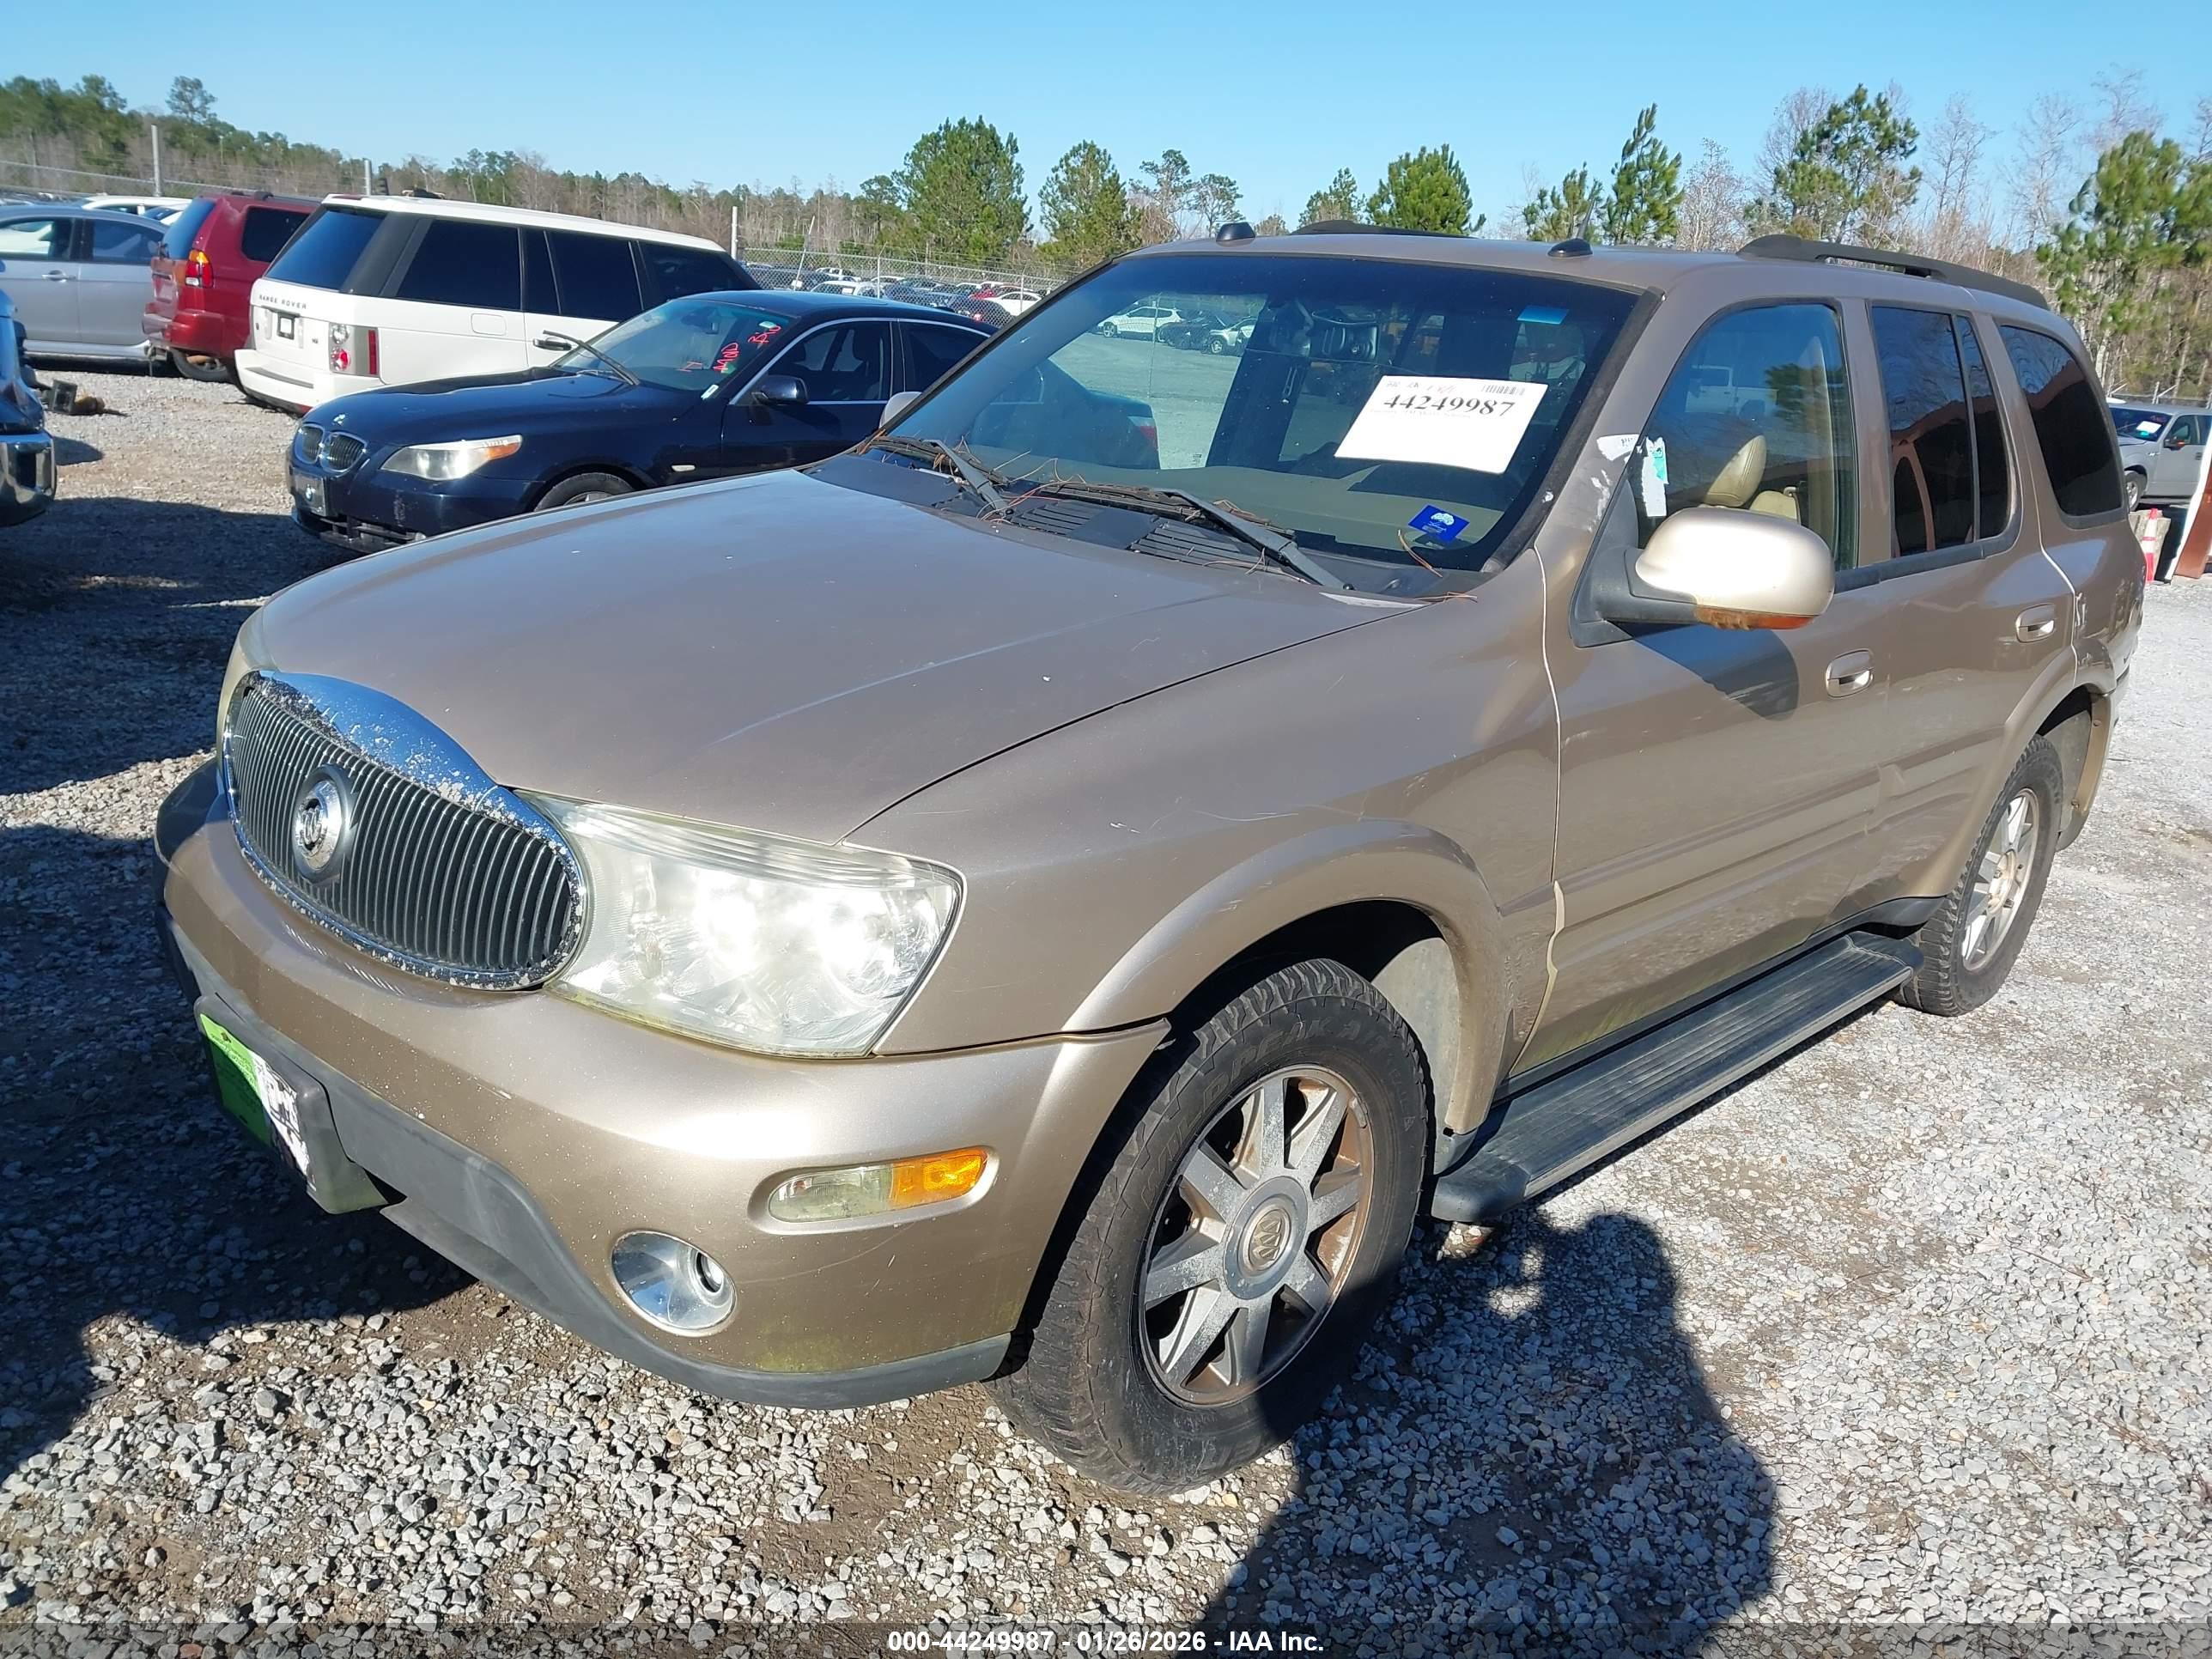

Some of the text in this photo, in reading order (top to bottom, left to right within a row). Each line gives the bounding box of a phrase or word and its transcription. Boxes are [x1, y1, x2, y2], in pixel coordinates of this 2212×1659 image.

[259, 295, 307, 309] RANGE ROVER
[1383, 394, 1516, 416] 44249987
